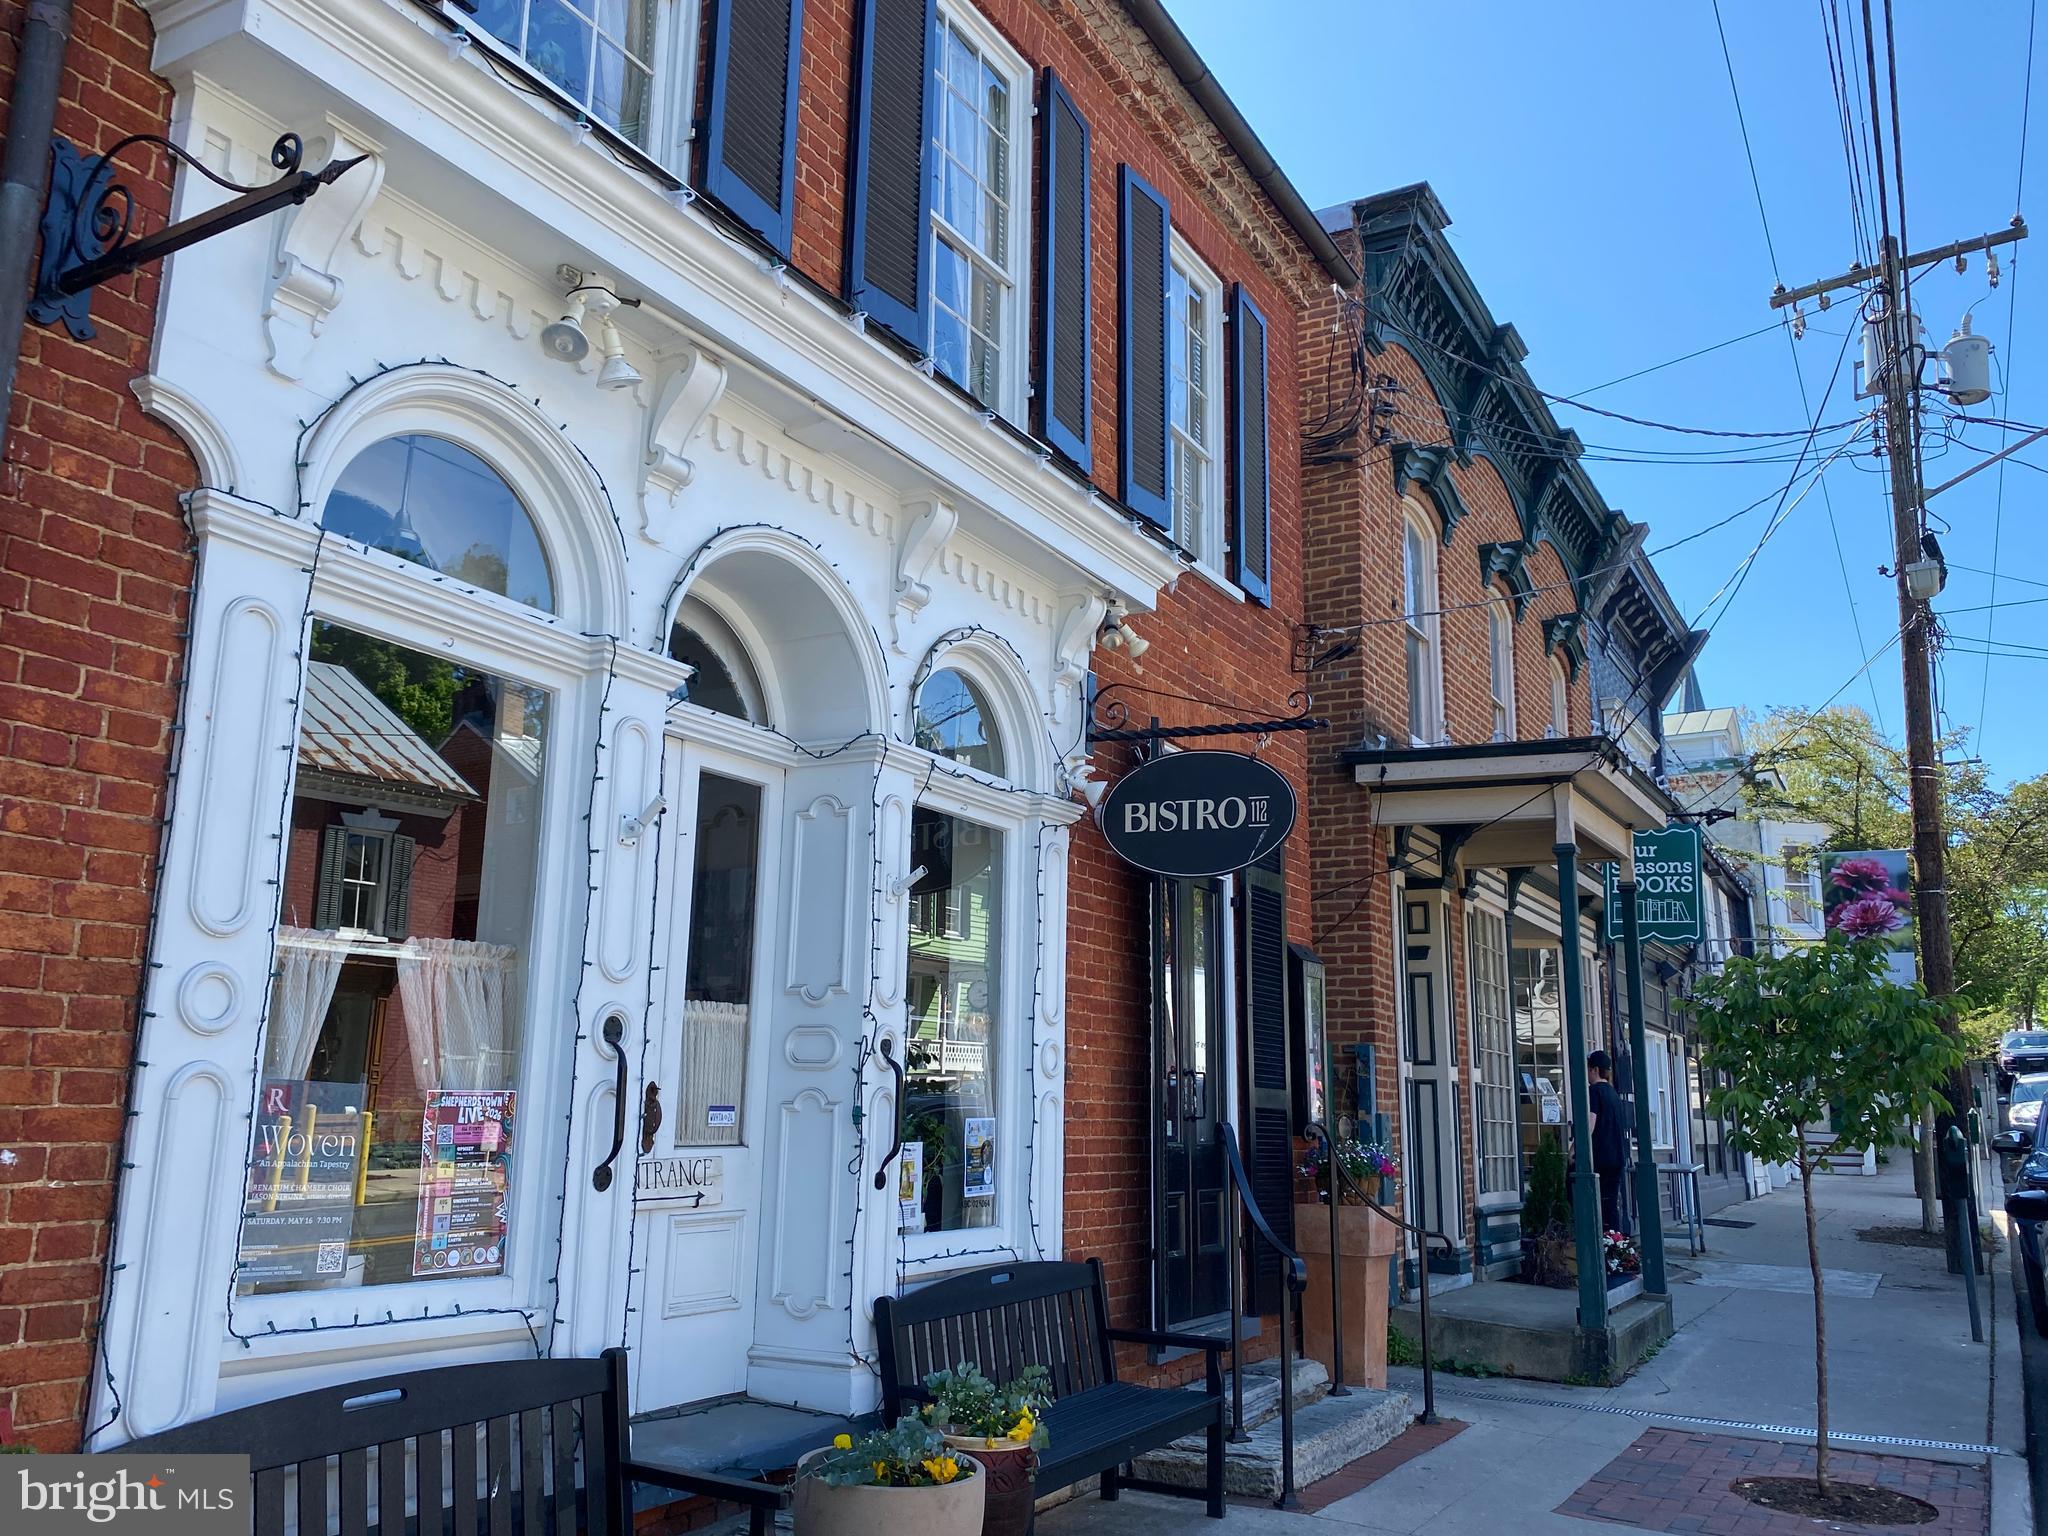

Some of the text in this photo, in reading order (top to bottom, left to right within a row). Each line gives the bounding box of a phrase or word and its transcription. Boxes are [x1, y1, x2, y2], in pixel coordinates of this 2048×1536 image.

[1124, 797, 1267, 833] BISTRO 112
[1634, 845, 1658, 858] ur
[1612, 861, 1693, 875] Sasons
[441, 1095, 503, 1107] SHEPHERDSTOWN
[457, 1106, 502, 1124] LIVE 2026
[261, 1125, 356, 1157] Woven
[271, 1160, 318, 1170] Appalachian
[319, 1160, 350, 1170] Tapestry
[290, 1183, 326, 1192] CHAMBER
[247, 1217, 287, 1226] SATURDAY,
[288, 1217, 304, 1225] MAY
[331, 1216, 343, 1224] PM
